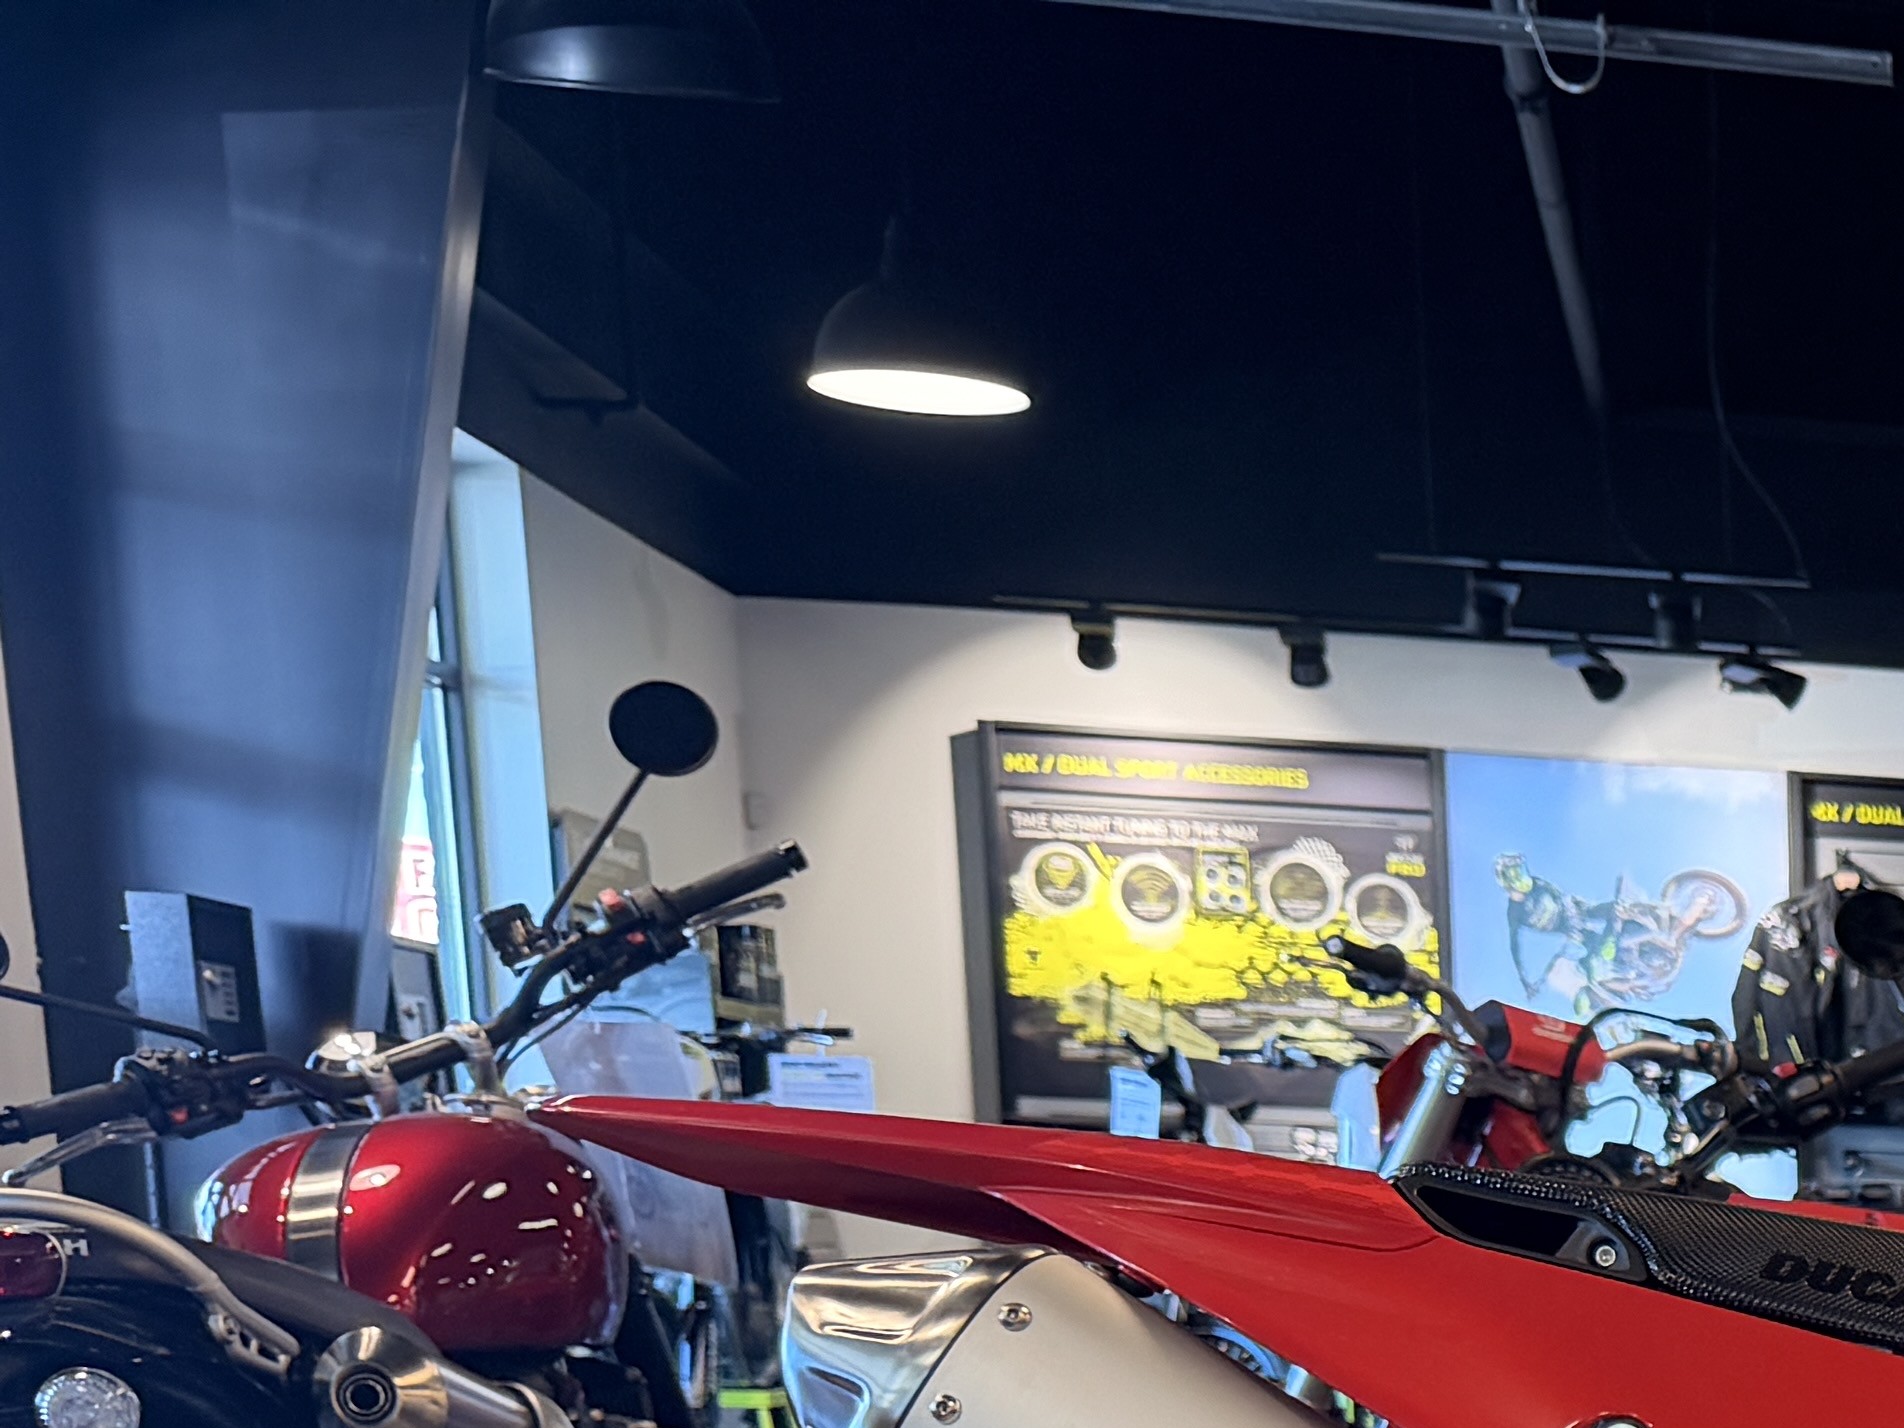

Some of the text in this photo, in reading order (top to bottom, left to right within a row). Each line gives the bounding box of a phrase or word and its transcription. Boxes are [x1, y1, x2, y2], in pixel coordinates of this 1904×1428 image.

[1056, 754, 1114, 778] DUAL
[1114, 757, 1181, 781] SPORT
[1182, 762, 1310, 790] ACCESSORIES
